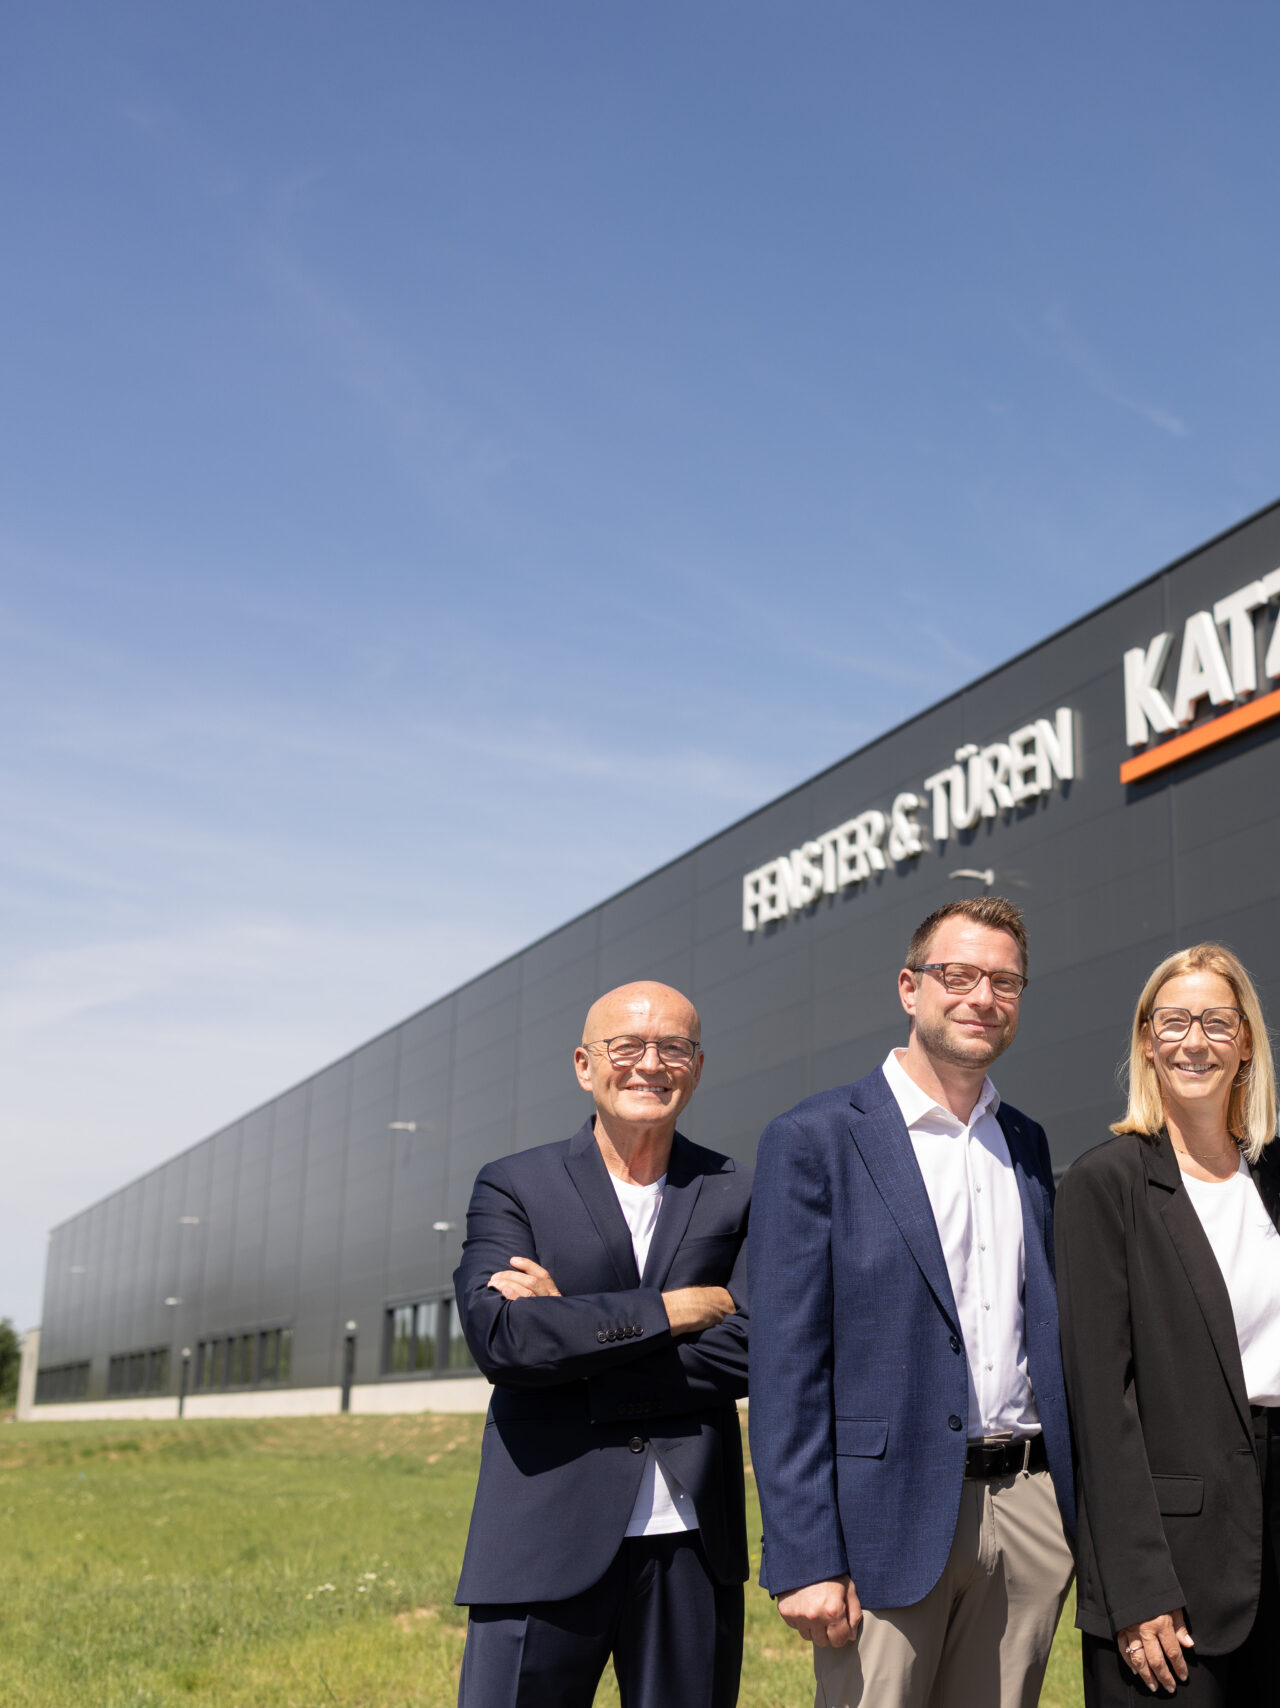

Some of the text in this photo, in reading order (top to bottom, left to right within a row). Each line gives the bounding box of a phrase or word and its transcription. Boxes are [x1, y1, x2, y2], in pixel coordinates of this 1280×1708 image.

[743, 707, 1075, 932] FENSTER & TÜREN
